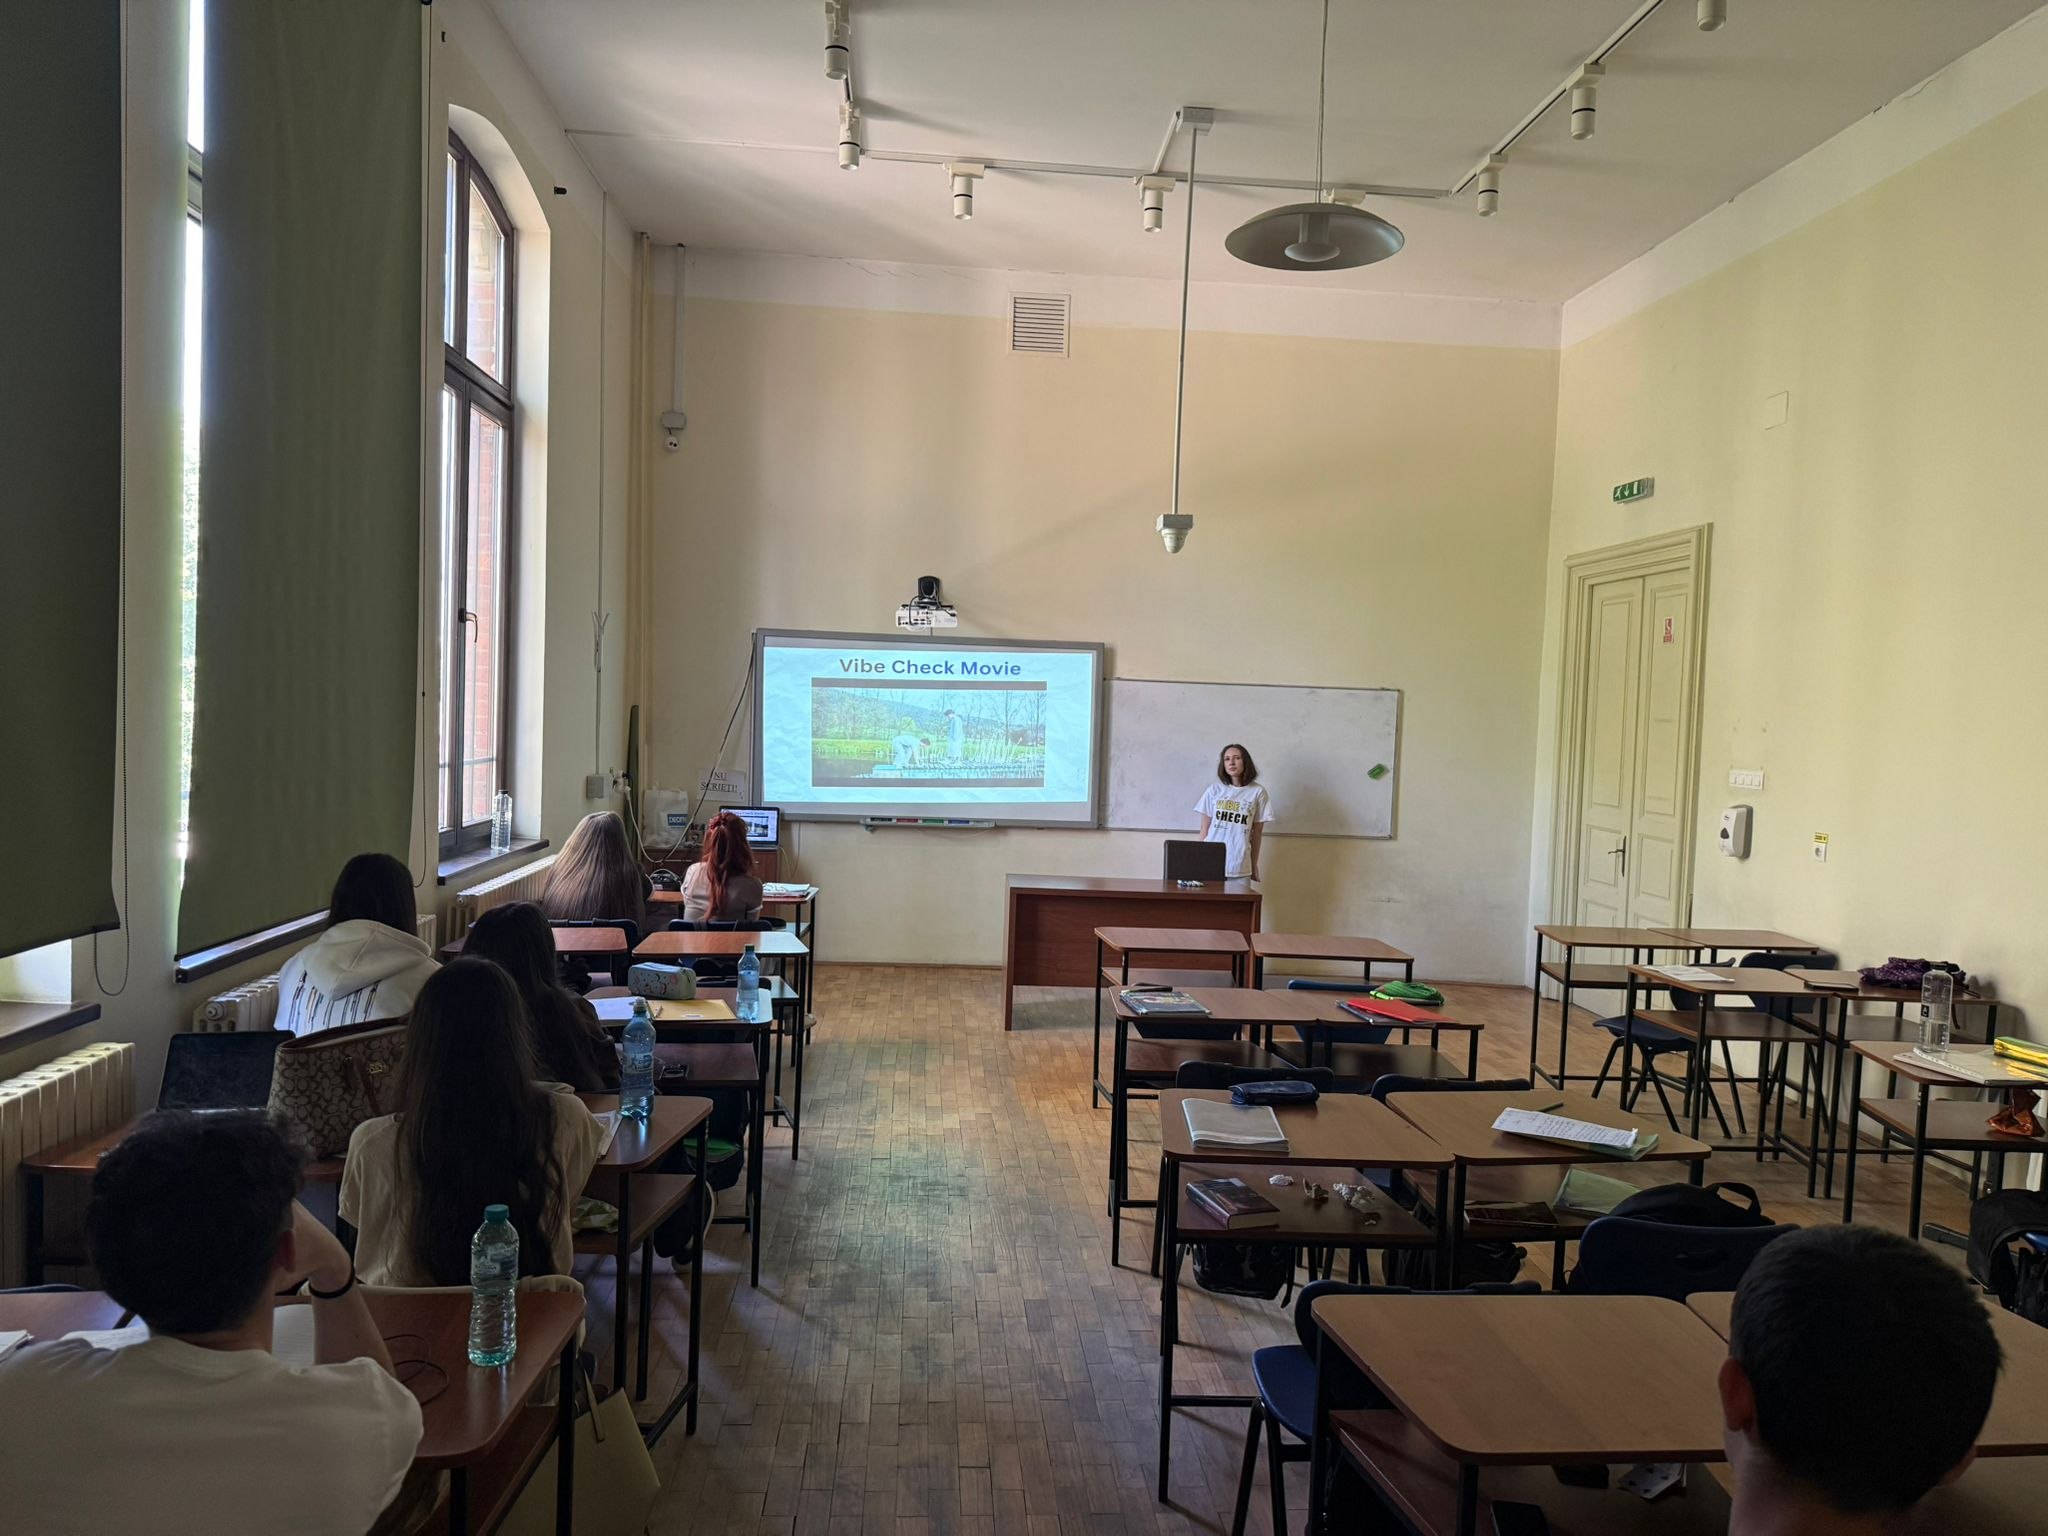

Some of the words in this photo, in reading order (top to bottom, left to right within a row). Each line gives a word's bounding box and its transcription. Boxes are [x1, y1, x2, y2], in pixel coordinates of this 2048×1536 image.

[839, 658, 886, 673] Vibe
[891, 659, 954, 675] Check
[961, 661, 1022, 676] Movie
[1216, 810, 1248, 825] CHECK
